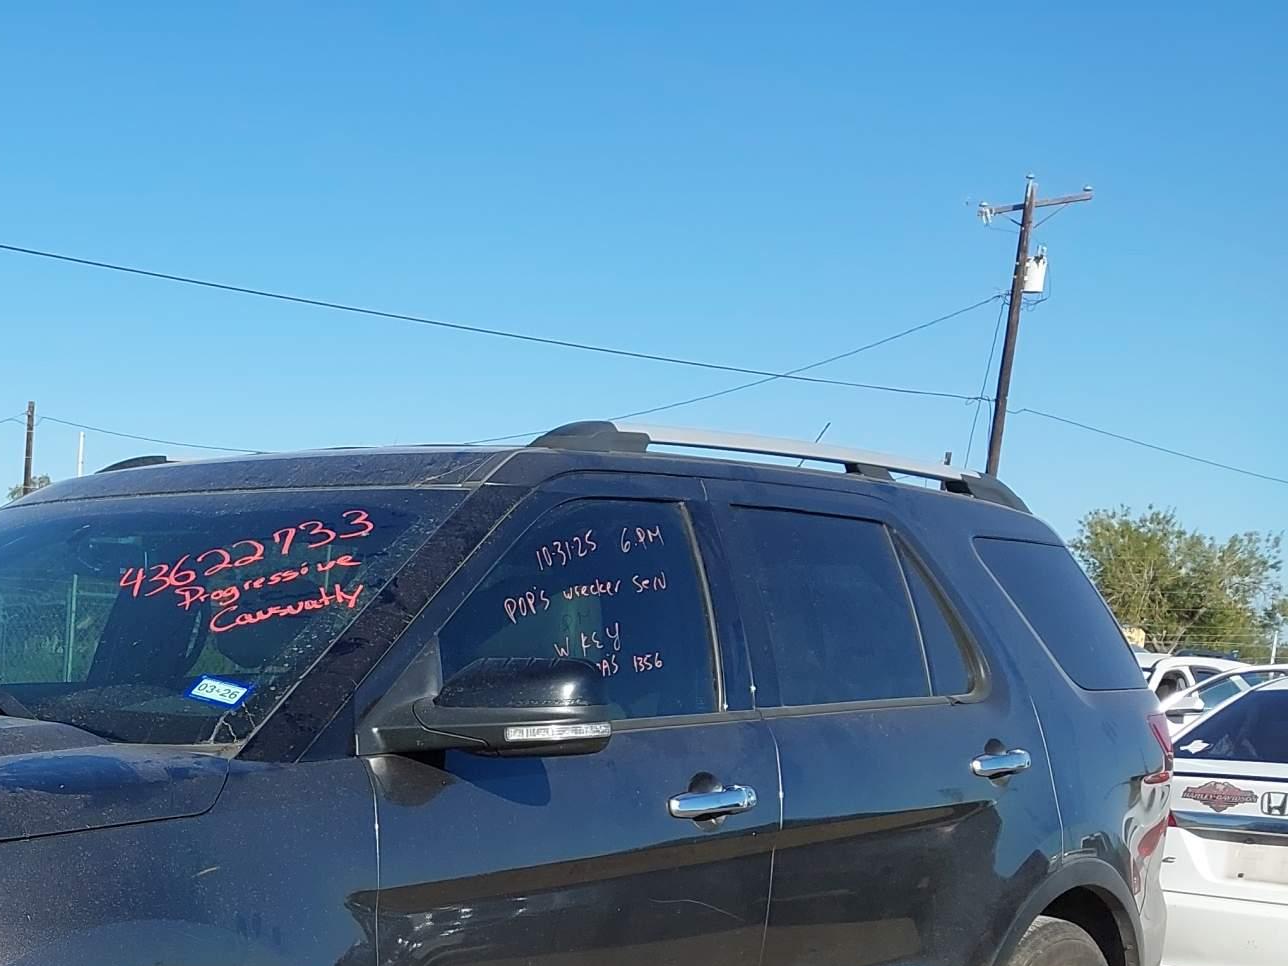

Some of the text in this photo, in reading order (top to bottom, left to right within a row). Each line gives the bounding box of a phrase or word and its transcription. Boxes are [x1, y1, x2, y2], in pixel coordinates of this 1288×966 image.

[120, 510, 374, 597] 43622733
[174, 555, 362, 610] Progressive
[633, 652, 663, 673] 1356
